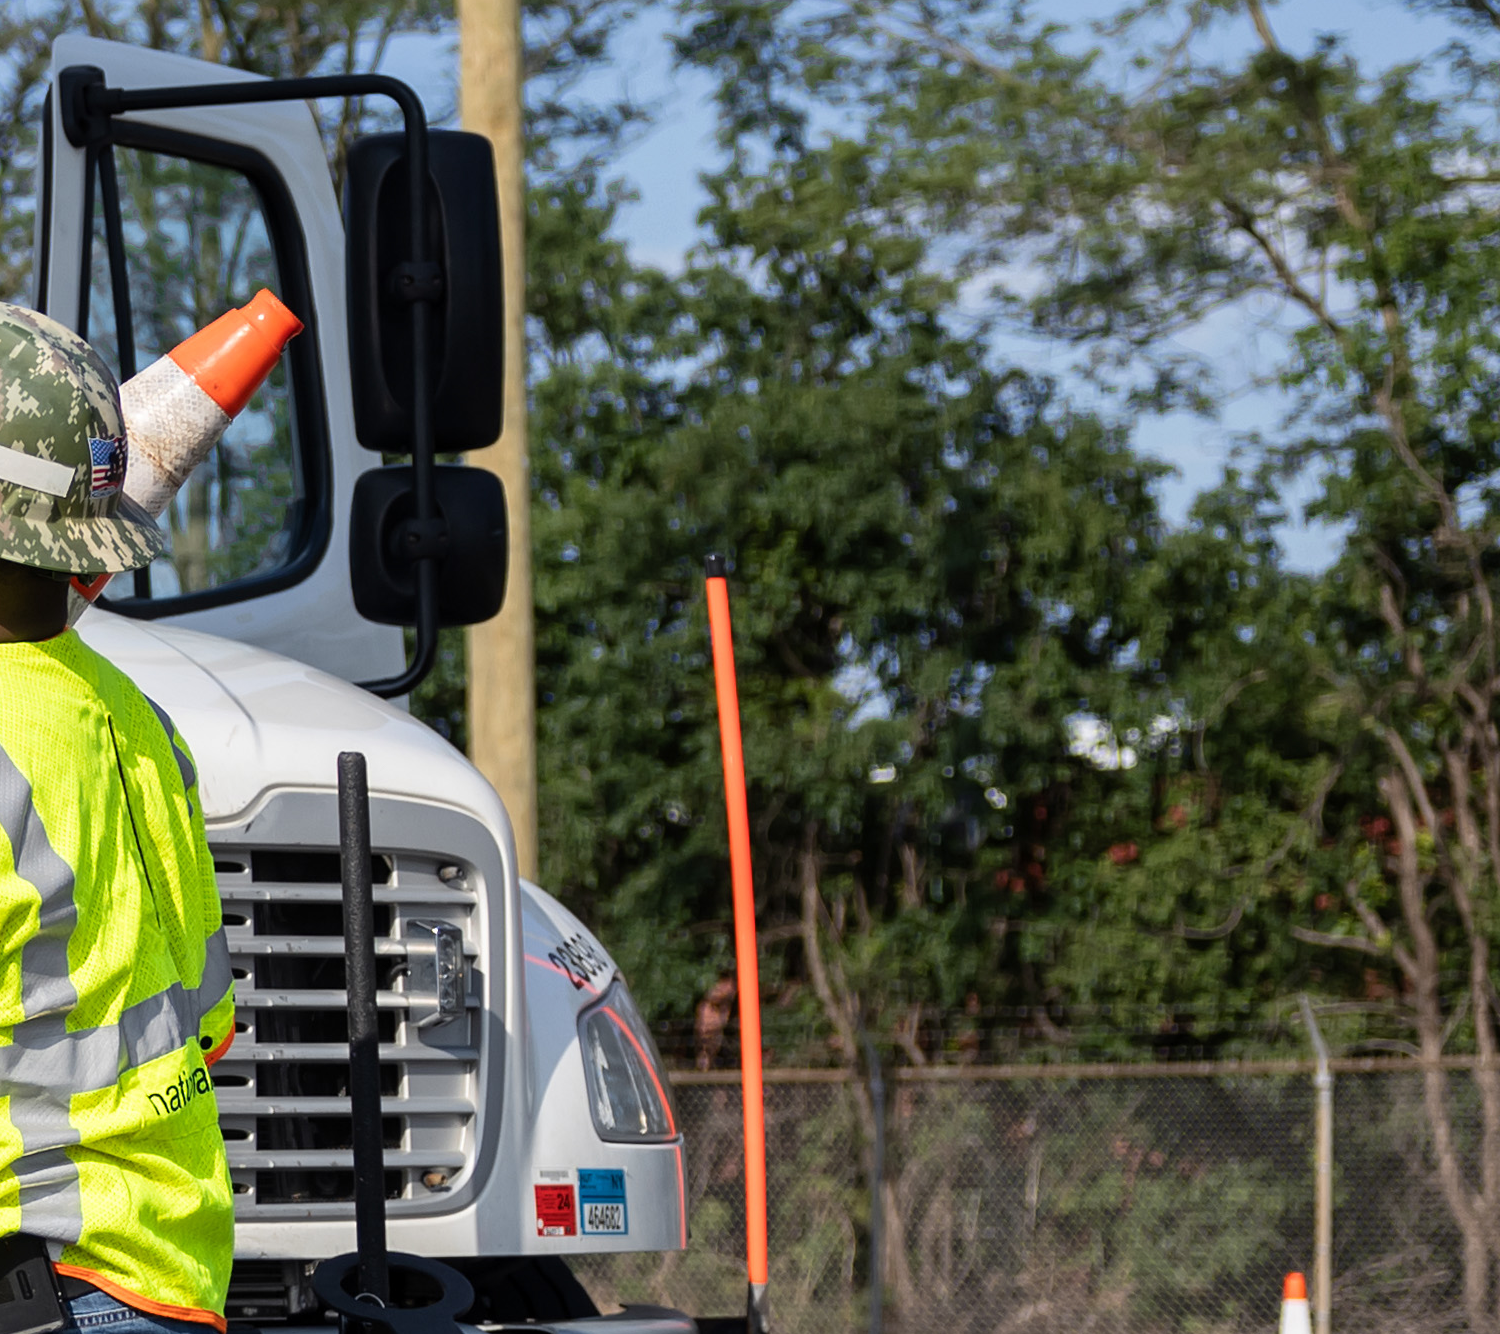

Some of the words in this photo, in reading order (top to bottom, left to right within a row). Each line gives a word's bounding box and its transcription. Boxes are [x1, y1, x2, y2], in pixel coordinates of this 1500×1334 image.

[611, 1173, 624, 1190] NY
[556, 1192, 571, 1210] 24
[588, 1205, 622, 1230] 464682
